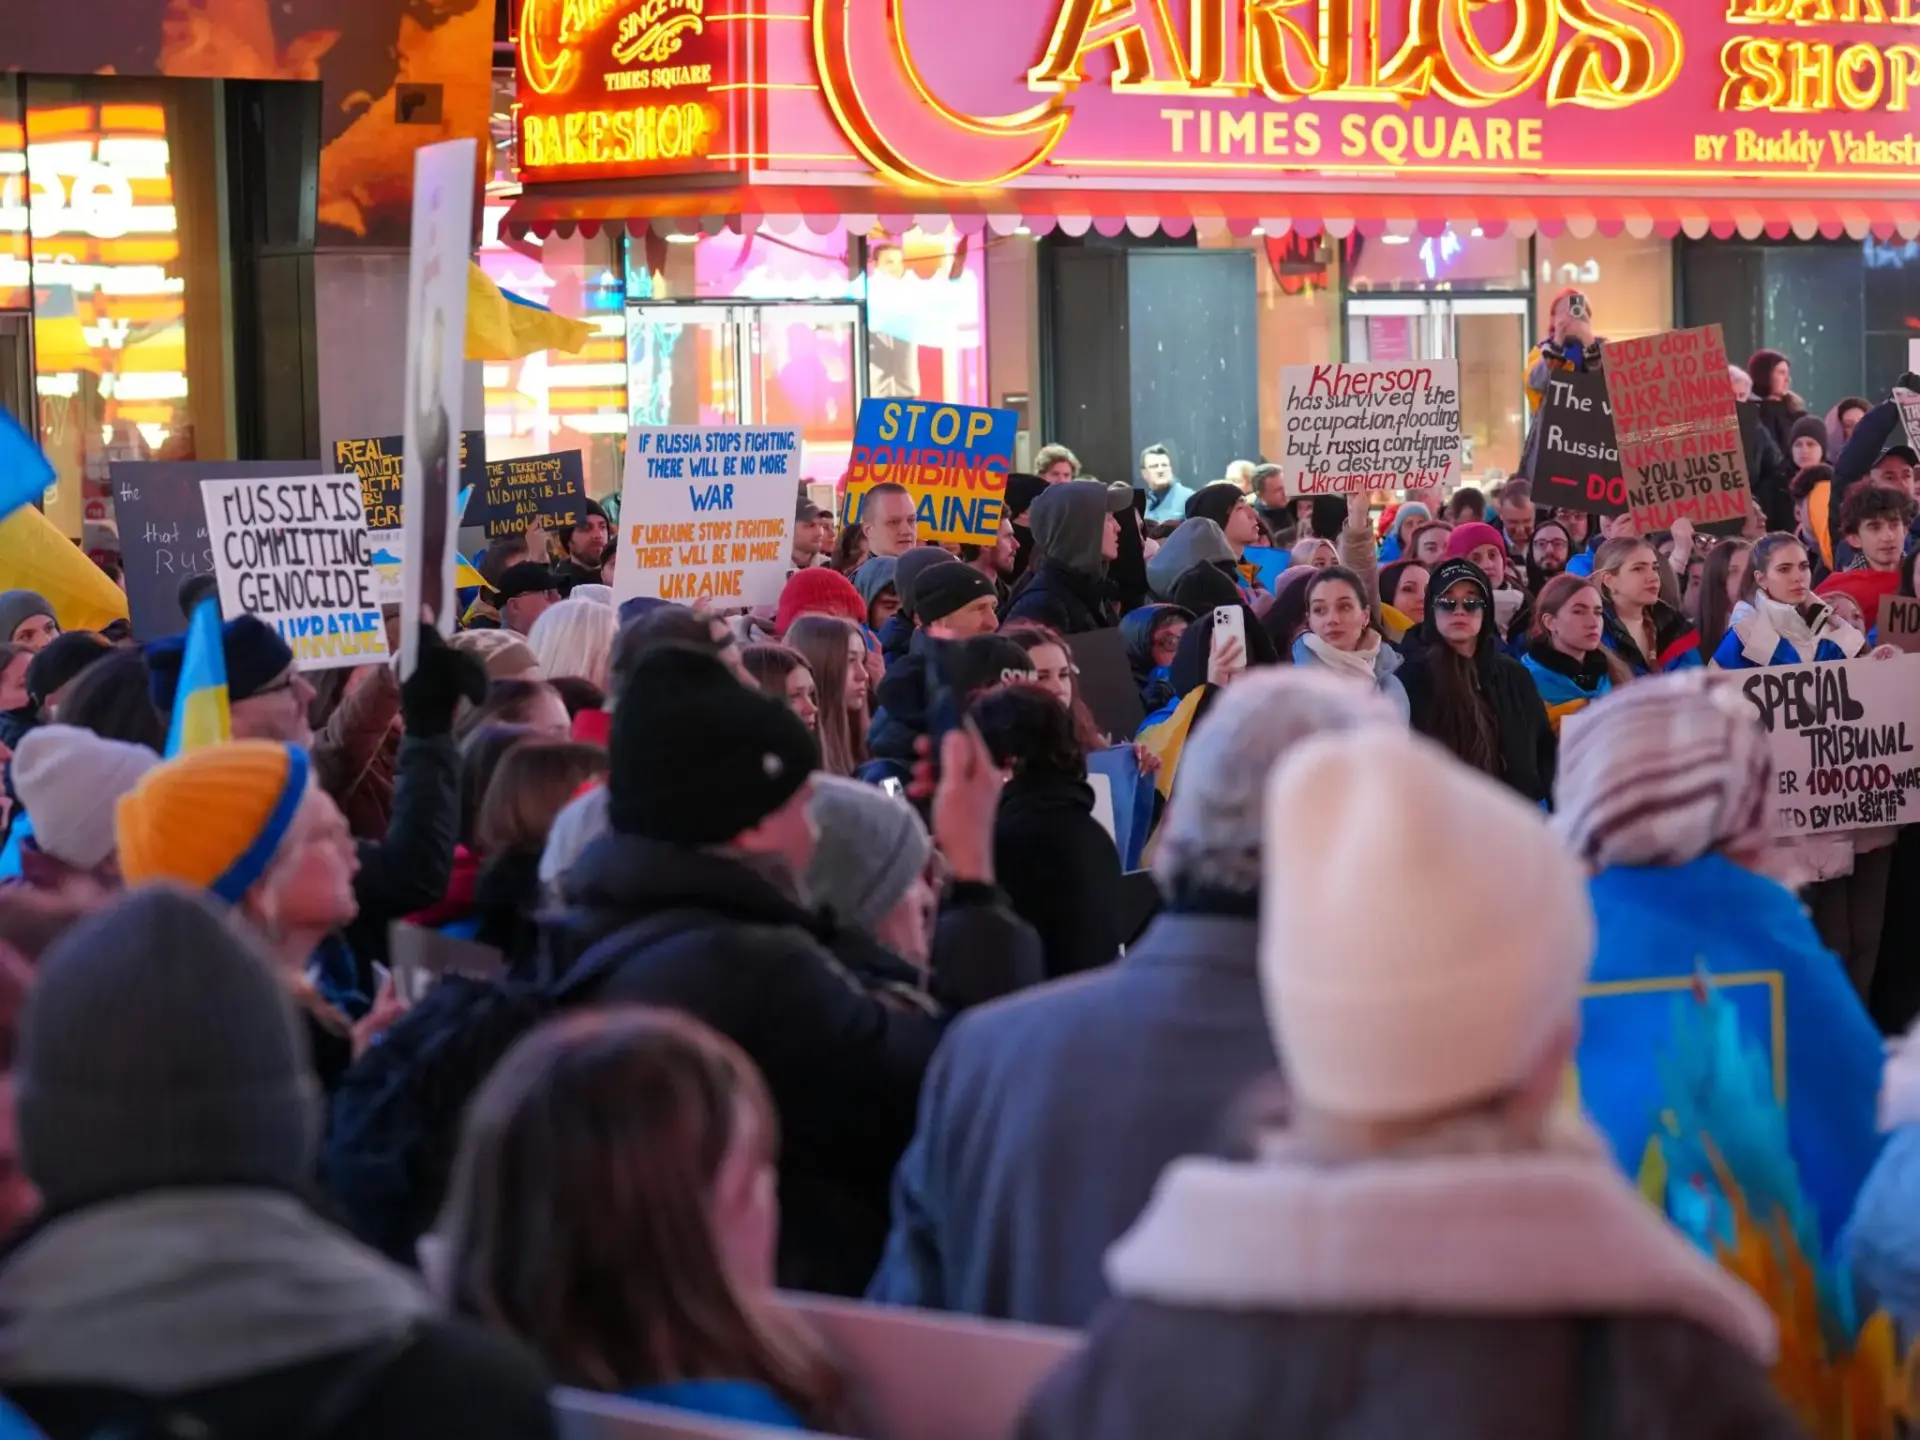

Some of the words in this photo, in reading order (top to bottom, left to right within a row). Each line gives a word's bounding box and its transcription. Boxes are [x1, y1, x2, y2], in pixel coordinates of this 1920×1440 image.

[604, 69, 650, 91] TIMES
[651, 65, 711, 89] SQUARE
[1718, 36, 1920, 112] SHOP
[1160, 109, 1321, 155] TIMES
[1340, 113, 1543, 165] SQUARE
[1694, 134, 1727, 161] BY
[1733, 127, 1825, 171] Buddy
[1307, 364, 1432, 396] Kherson
[1287, 386, 1321, 411] has
[1324, 388, 1415, 410] survived
[1424, 386, 1456, 405] the
[1550, 380, 1593, 413] The
[879, 402, 993, 449] STOP
[337, 439, 392, 464] REAL
[638, 432, 651, 453] IF
[656, 432, 702, 454] RUSSIA
[705, 432, 741, 453] STOPS
[1286, 433, 1322, 456] but
[1326, 437, 1380, 456] russia
[1383, 429, 1459, 452] continues
[1547, 424, 1618, 462] Russia
[1623, 431, 1736, 468] UKRAINE
[343, 456, 404, 478] CANNOT
[485, 464, 505, 476] THE
[508, 458, 561, 474] TERRITORY
[647, 457, 684, 478] THERE
[690, 456, 718, 477] WILL
[723, 456, 737, 476] BE
[740, 455, 755, 475] NO
[759, 454, 788, 474] MORE
[849, 445, 1010, 491] BOMBING
[1305, 455, 1331, 474] to
[1337, 452, 1413, 475] destroy
[1416, 450, 1450, 469] the
[1637, 461, 1679, 486] YOU
[1683, 450, 1738, 479] JUST
[120, 482, 141, 502] the
[360, 475, 404, 492] ICTA
[489, 477, 502, 488] OF
[507, 472, 548, 486] UKRAINE
[553, 471, 562, 481] IS
[1298, 471, 1397, 494] Ukrainian
[1403, 461, 1451, 489] city!
[1586, 472, 1627, 505] DO
[1628, 482, 1685, 508] NEED
[1685, 476, 1713, 496] TO
[1720, 470, 1745, 491] BE
[326, 482, 362, 522] IS
[362, 492, 383, 506] BY
[486, 481, 577, 506] INDIVISIBLE
[515, 500, 538, 515] AND
[689, 483, 734, 512] WAR
[490, 511, 577, 536] INVIOLBLE
[843, 492, 1002, 535] UAINE
[1632, 489, 1747, 535] HUMAN
[142, 520, 180, 543] that
[631, 524, 644, 545] IF
[646, 522, 695, 544] UKRAINE
[698, 520, 732, 541] STOPS
[224, 527, 373, 570] COMMITTING
[635, 547, 673, 569] THERE
[679, 545, 708, 566] WILL
[712, 544, 727, 564] BE
[731, 543, 746, 563] NO
[749, 541, 781, 562] MORE
[238, 569, 376, 613] GENOCIDE
[659, 569, 744, 599] UKRAINE
[1805, 763, 1891, 800] 100,000
[1810, 804, 1832, 830] BY
